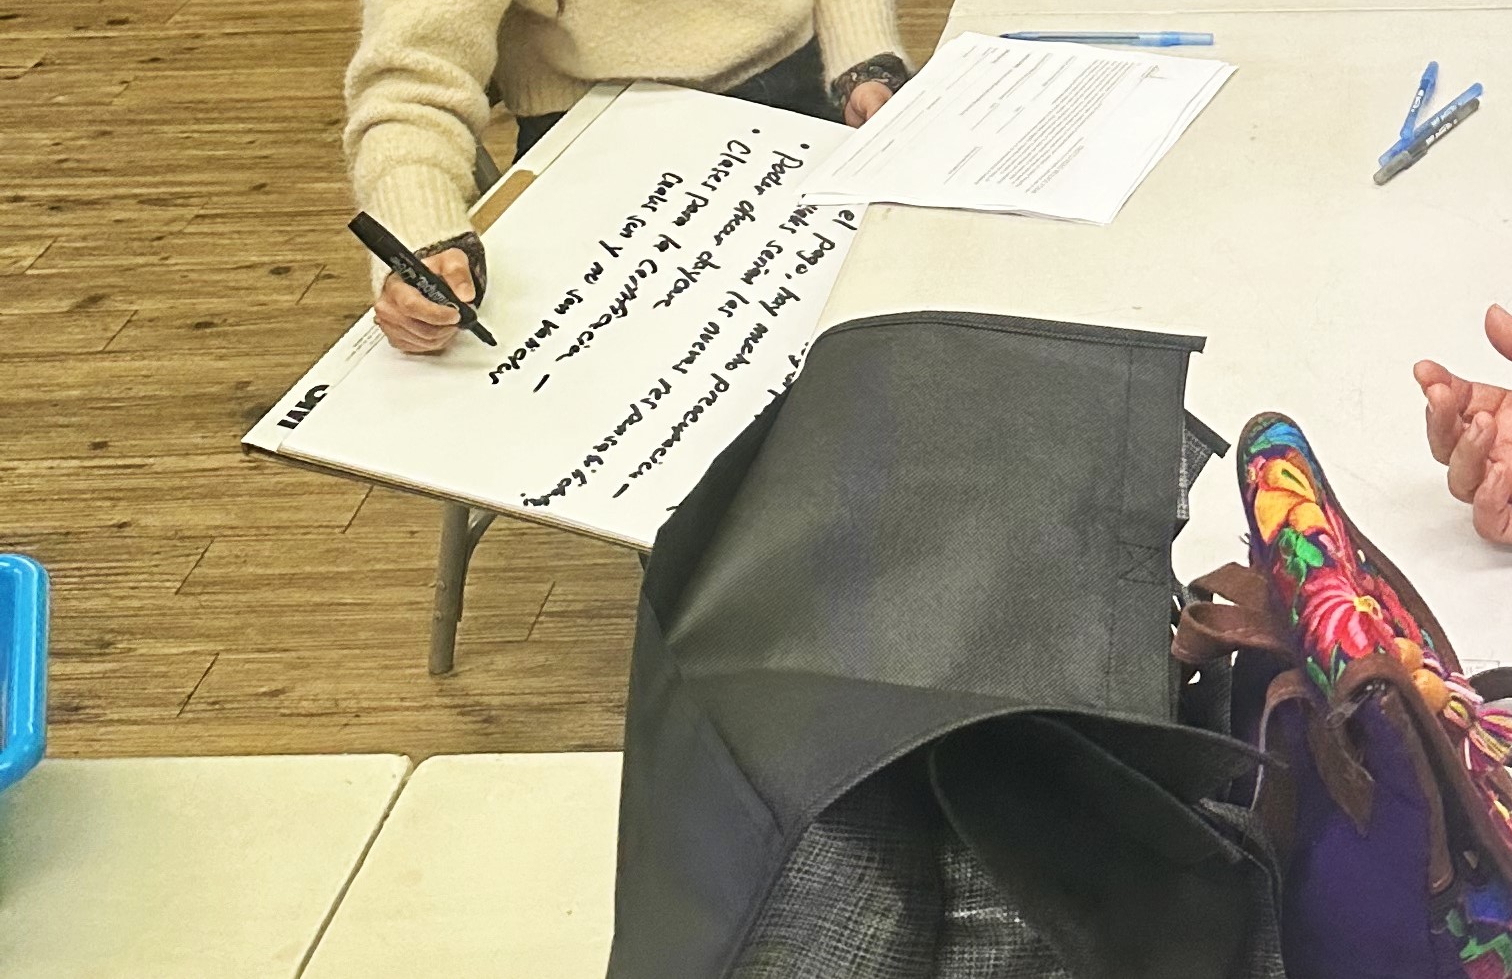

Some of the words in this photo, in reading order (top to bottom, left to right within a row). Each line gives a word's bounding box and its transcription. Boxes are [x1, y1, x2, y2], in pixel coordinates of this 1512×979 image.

[701, 140, 751, 191] Clases
[672, 192, 708, 226] para
[833, 210, 857, 230] el
[759, 287, 800, 316] hay
[725, 323, 768, 370] mucho
